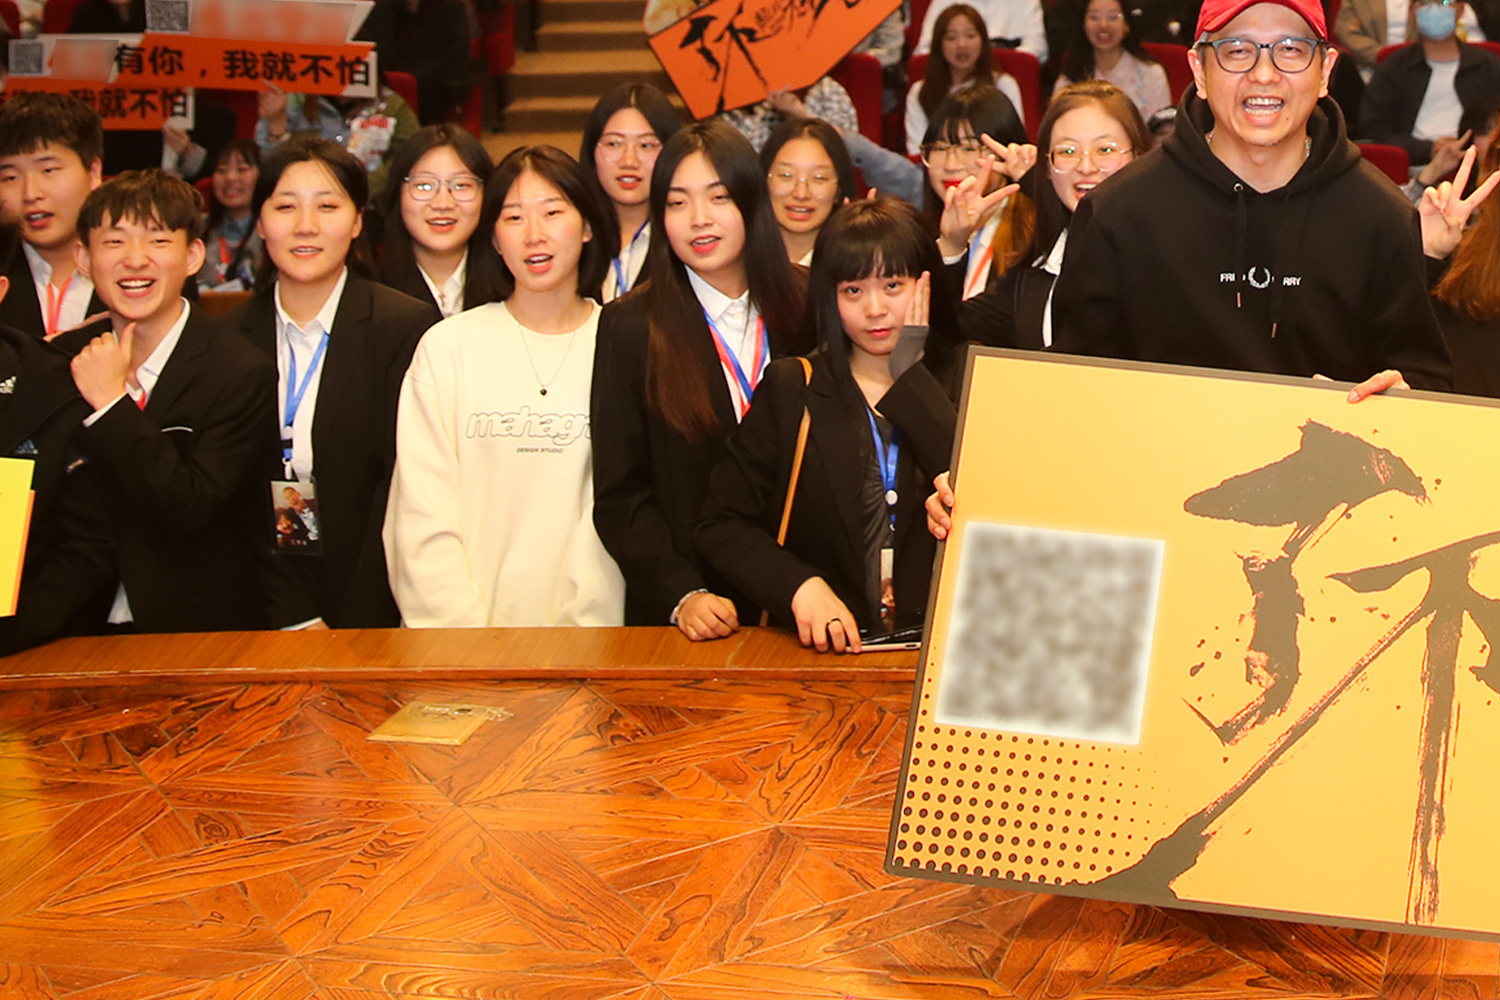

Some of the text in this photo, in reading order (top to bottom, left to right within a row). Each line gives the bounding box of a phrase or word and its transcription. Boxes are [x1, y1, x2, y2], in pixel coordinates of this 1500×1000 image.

[114, 43, 371, 87] 有你，我就不怕
